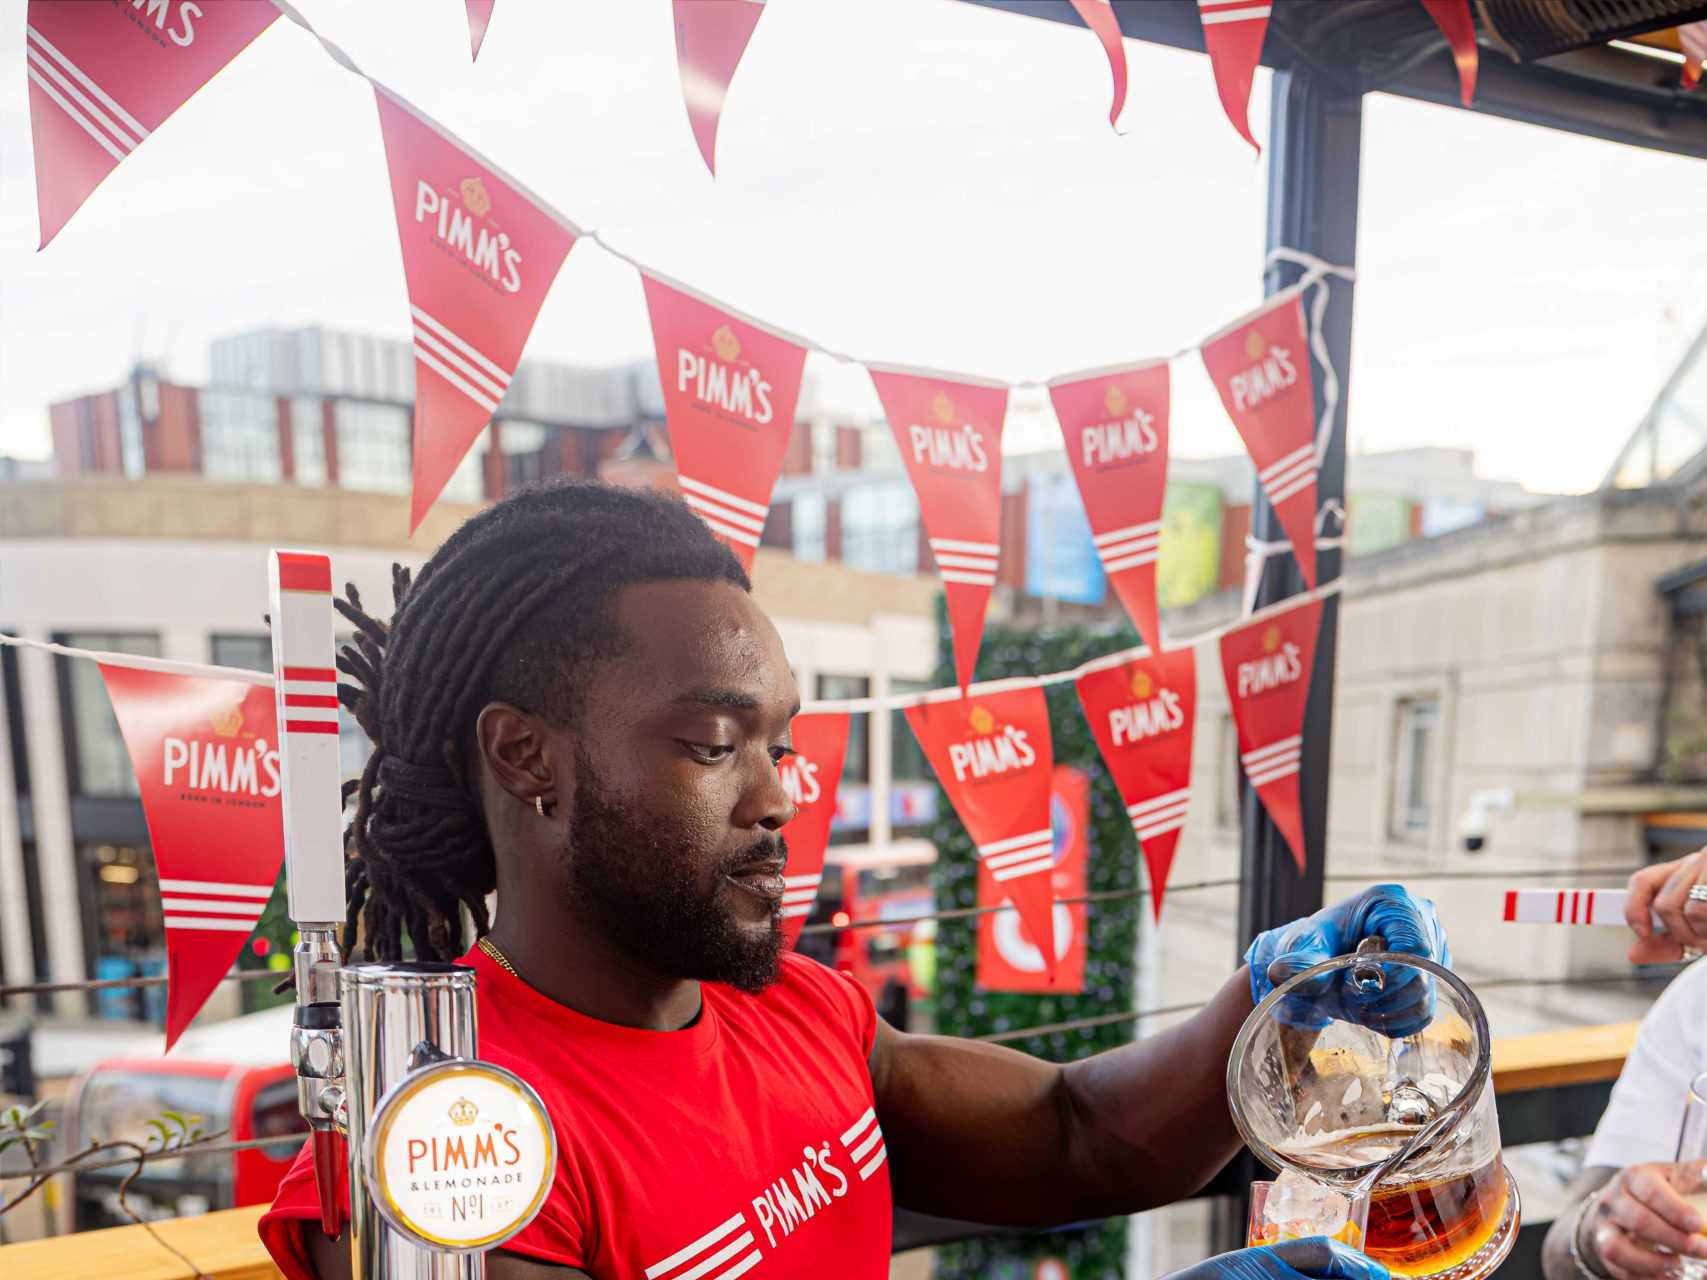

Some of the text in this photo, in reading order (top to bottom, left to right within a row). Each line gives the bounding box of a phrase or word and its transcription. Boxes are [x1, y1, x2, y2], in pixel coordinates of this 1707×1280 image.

[415, 180, 521, 292] PIMM'S
[678, 348, 773, 424] PIMM'S
[1229, 346, 1297, 413] PIMM'S
[909, 424, 988, 472] PIMM'S
[1082, 408, 1158, 467] PIMM'S
[1237, 642, 1302, 698] PIMM'S
[1108, 688, 1184, 746] PIMM'S
[164, 737, 281, 797] PIMM'S
[949, 725, 1036, 782] PIMM'S
[408, 1122, 520, 1174] PIMM'S
[751, 1141, 848, 1248] PIMM'S
